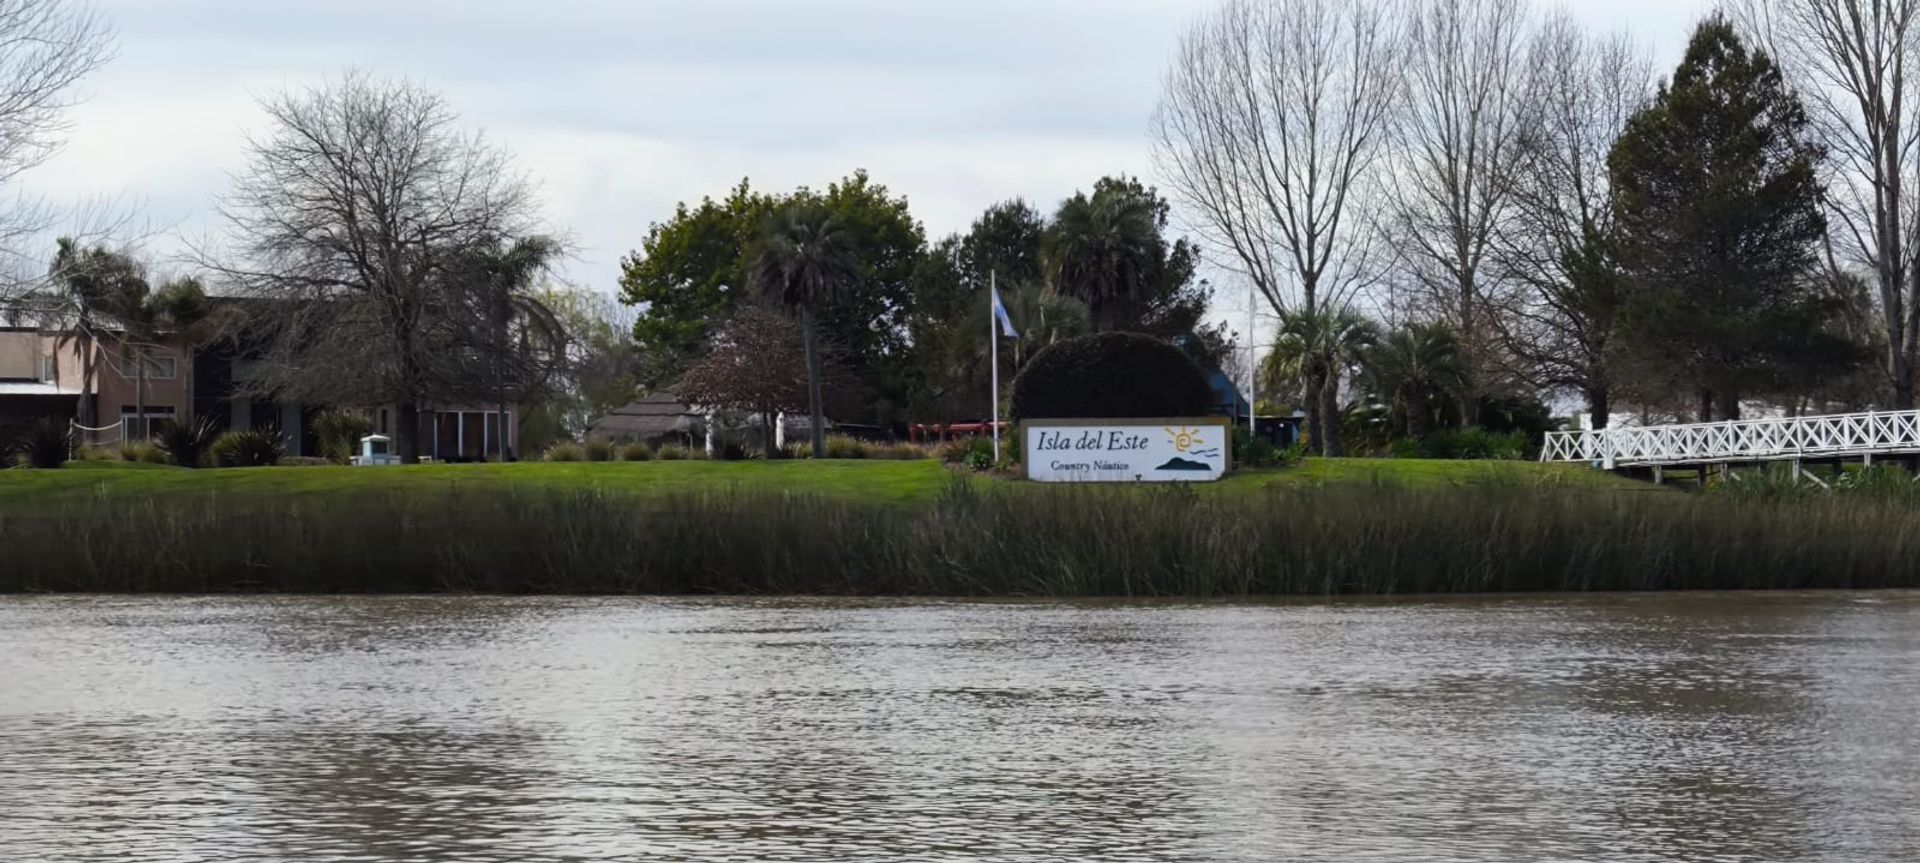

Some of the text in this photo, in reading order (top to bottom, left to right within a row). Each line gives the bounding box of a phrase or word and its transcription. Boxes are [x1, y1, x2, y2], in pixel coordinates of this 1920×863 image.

[1037, 430, 1149, 450] Isla del Este
[1051, 460, 1129, 473] Country Náutico
